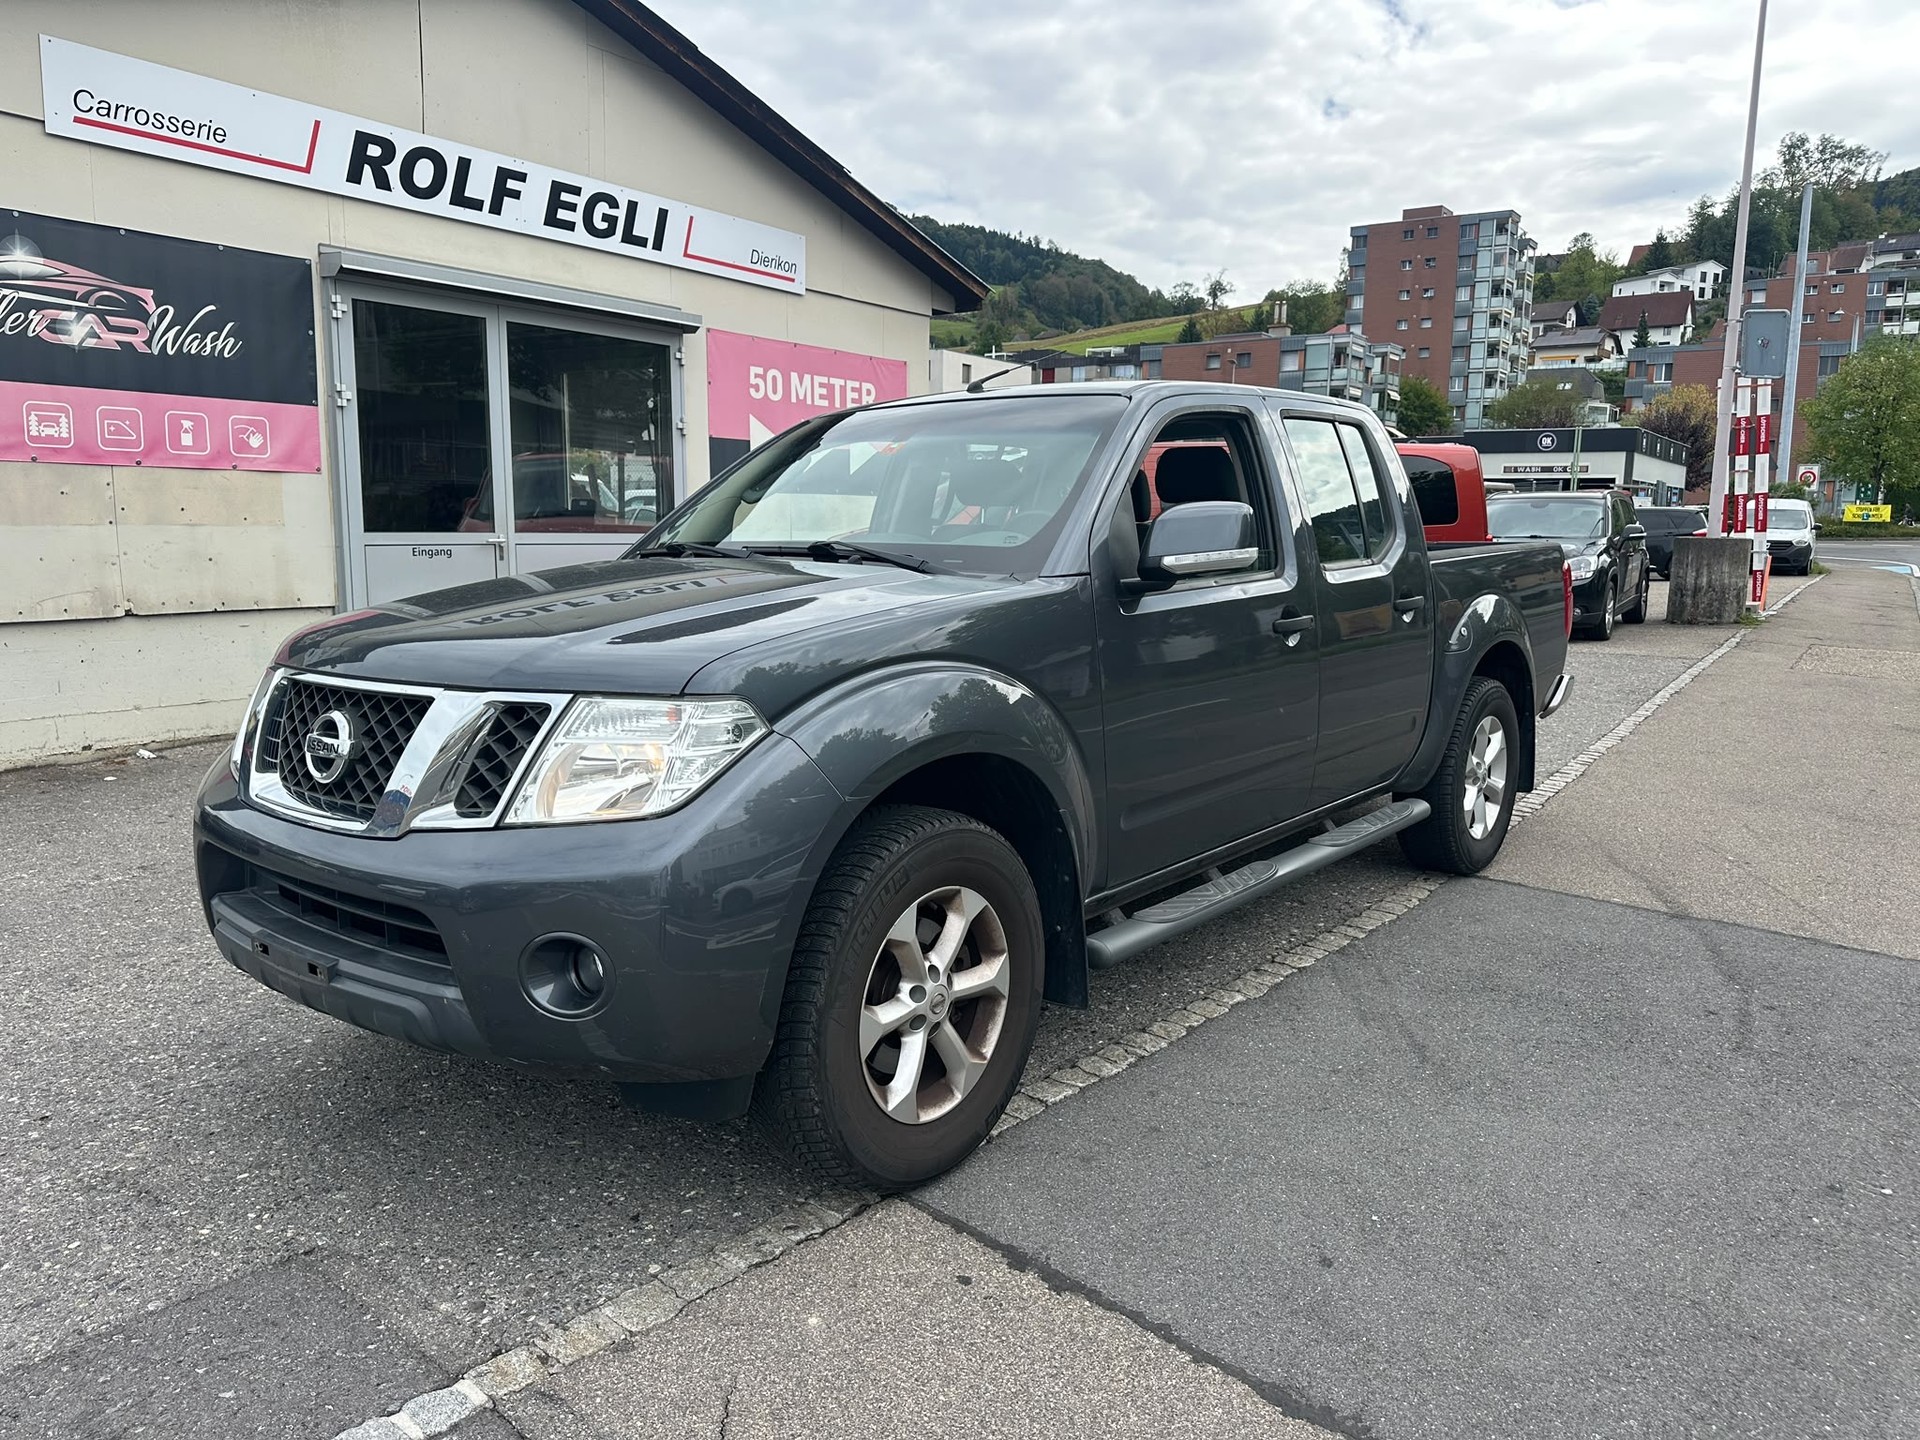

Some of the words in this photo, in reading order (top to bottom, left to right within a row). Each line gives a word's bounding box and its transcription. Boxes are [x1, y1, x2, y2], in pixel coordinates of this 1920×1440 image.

[73, 89, 227, 144] Carrosserie
[345, 129, 528, 217] ROLF
[543, 180, 669, 251] EGLI
[749, 249, 797, 275] Dierikon
[148, 304, 242, 359] Wash
[749, 366, 783, 402] 50
[790, 372, 876, 408] METER
[411, 547, 453, 559] Eingang
